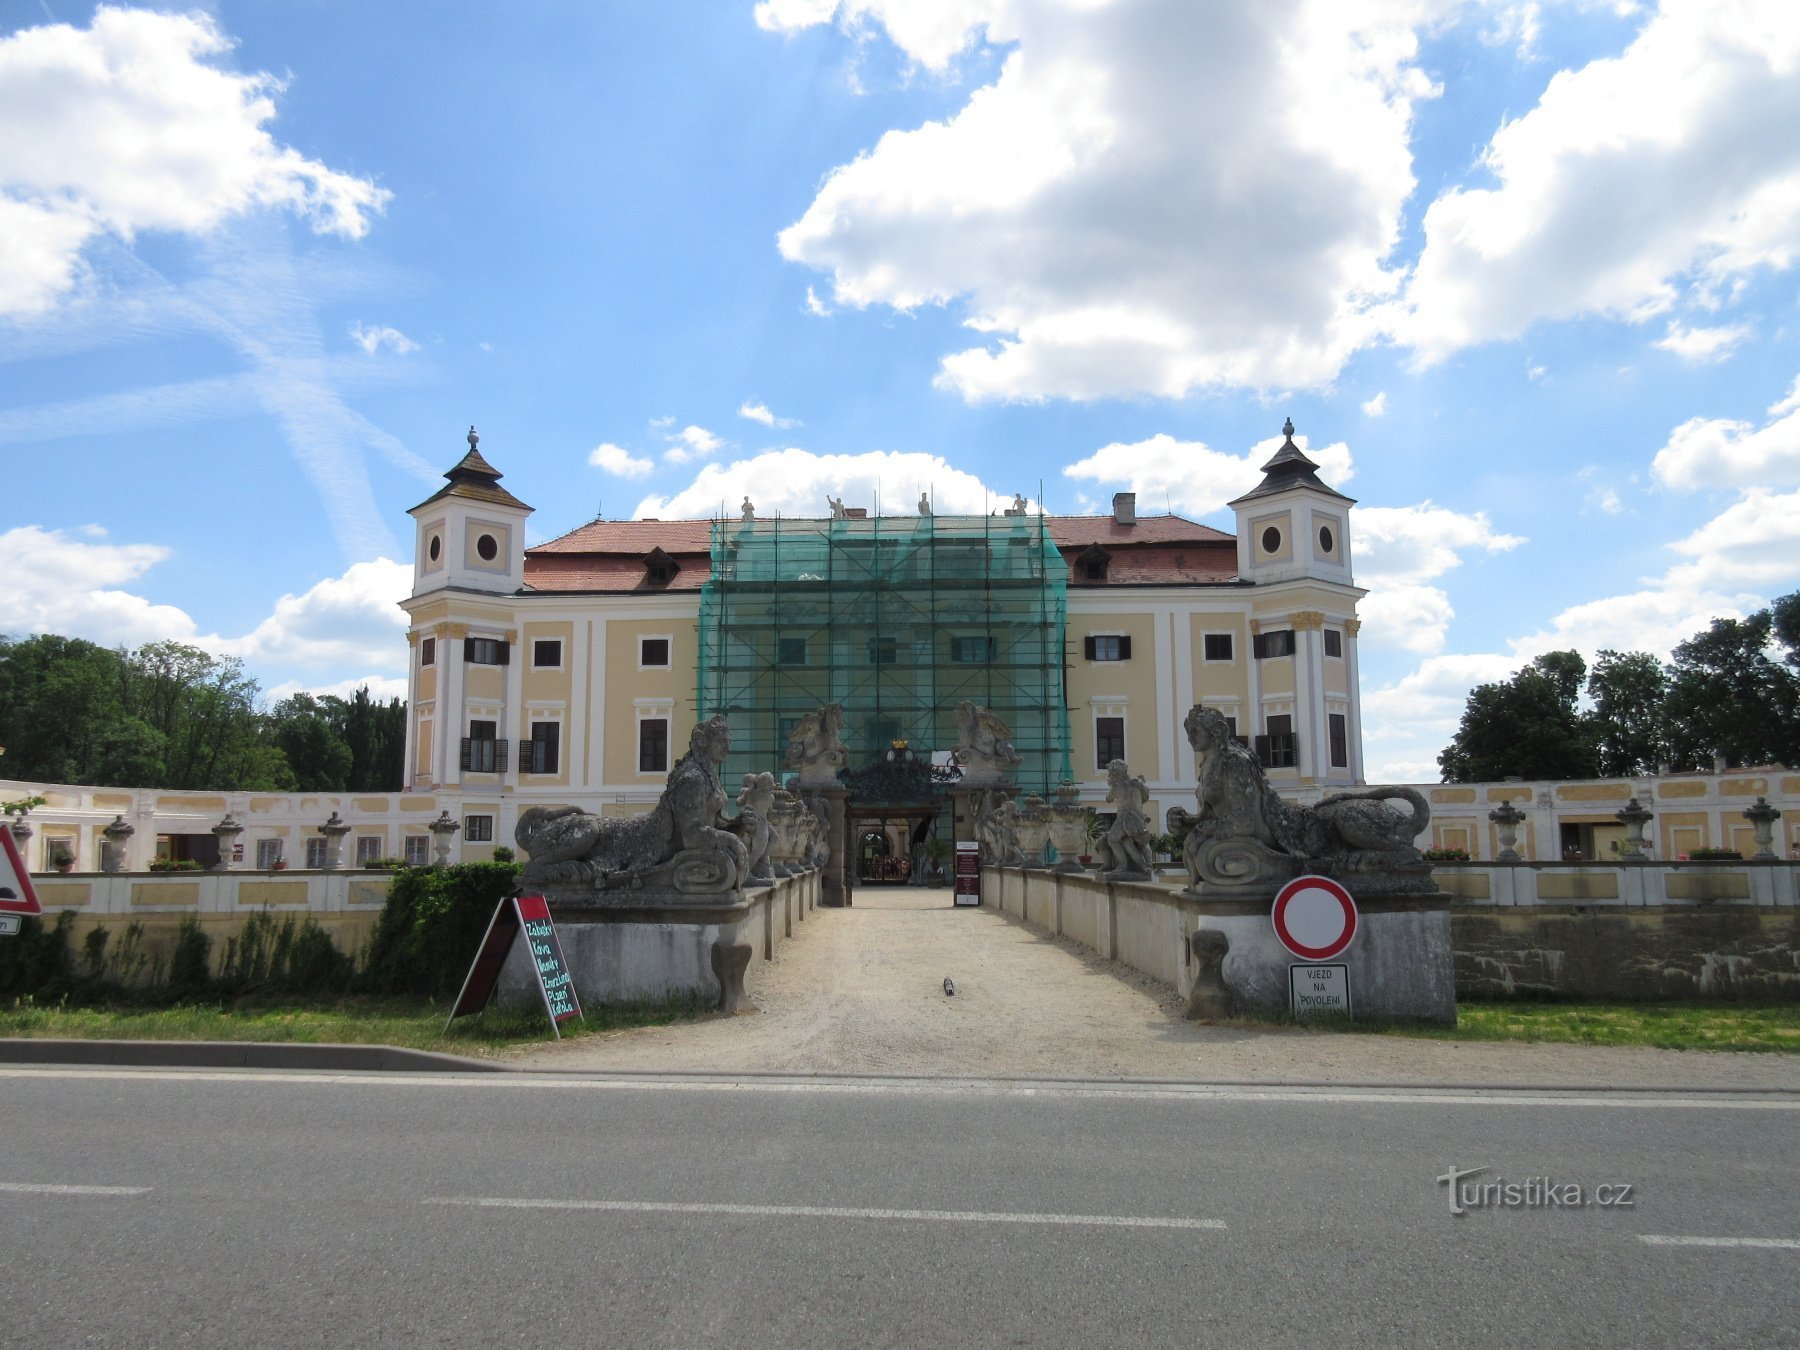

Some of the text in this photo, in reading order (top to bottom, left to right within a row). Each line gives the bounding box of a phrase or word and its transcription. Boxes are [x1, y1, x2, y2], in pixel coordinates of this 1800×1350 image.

[531, 939, 552, 955] Káva
[1306, 969, 1332, 979] VJEZD
[1313, 982, 1326, 992] NA
